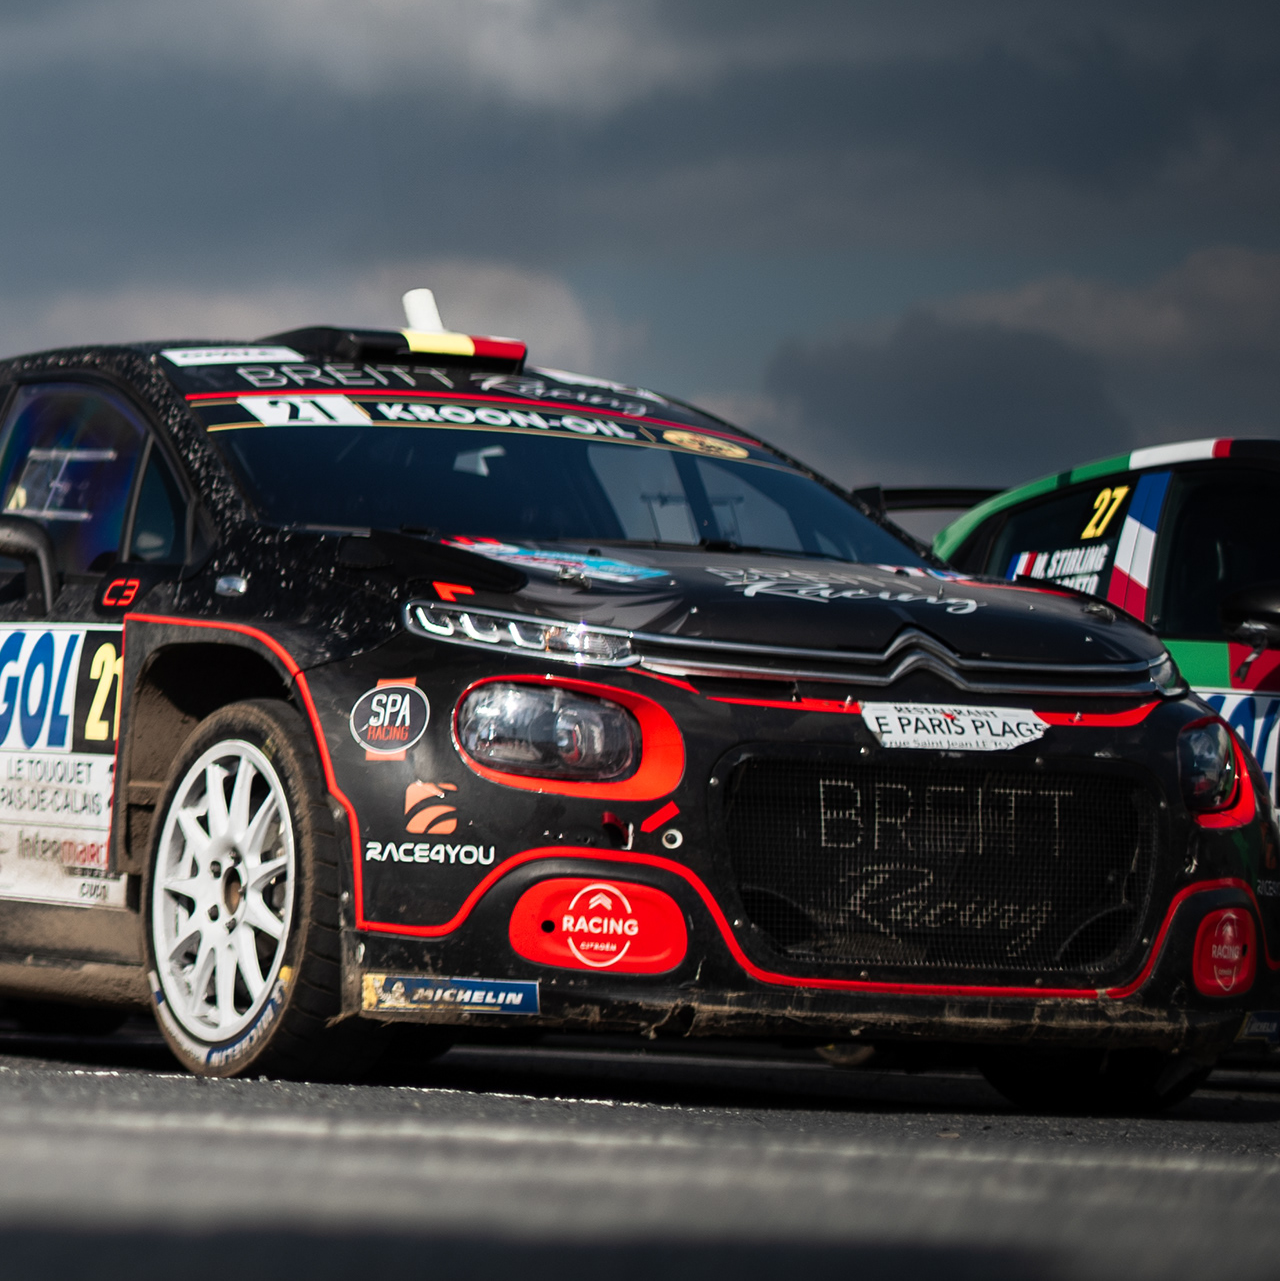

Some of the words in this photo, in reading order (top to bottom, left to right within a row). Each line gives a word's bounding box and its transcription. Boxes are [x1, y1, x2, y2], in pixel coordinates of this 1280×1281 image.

[236, 363, 455, 389] BREITT
[376, 402, 637, 439] KROON-OIL
[1080, 485, 1131, 540] 27
[1047, 543, 1109, 578] STIRLING
[102, 578, 140, 606] C3
[369, 693, 411, 727] SPA
[367, 726, 410, 741] RACING
[875, 716, 893, 734] E
[898, 717, 965, 736] PARIS
[6, 757, 24, 781] LE
[28, 760, 93, 784] TOUQUET
[17, 829, 106, 865] Intermarc
[365, 841, 496, 865] RACE4YOU
[561, 914, 639, 936] RACING
[1211, 944, 1240, 960] RACING
[410, 987, 524, 1006] MICHELIN
